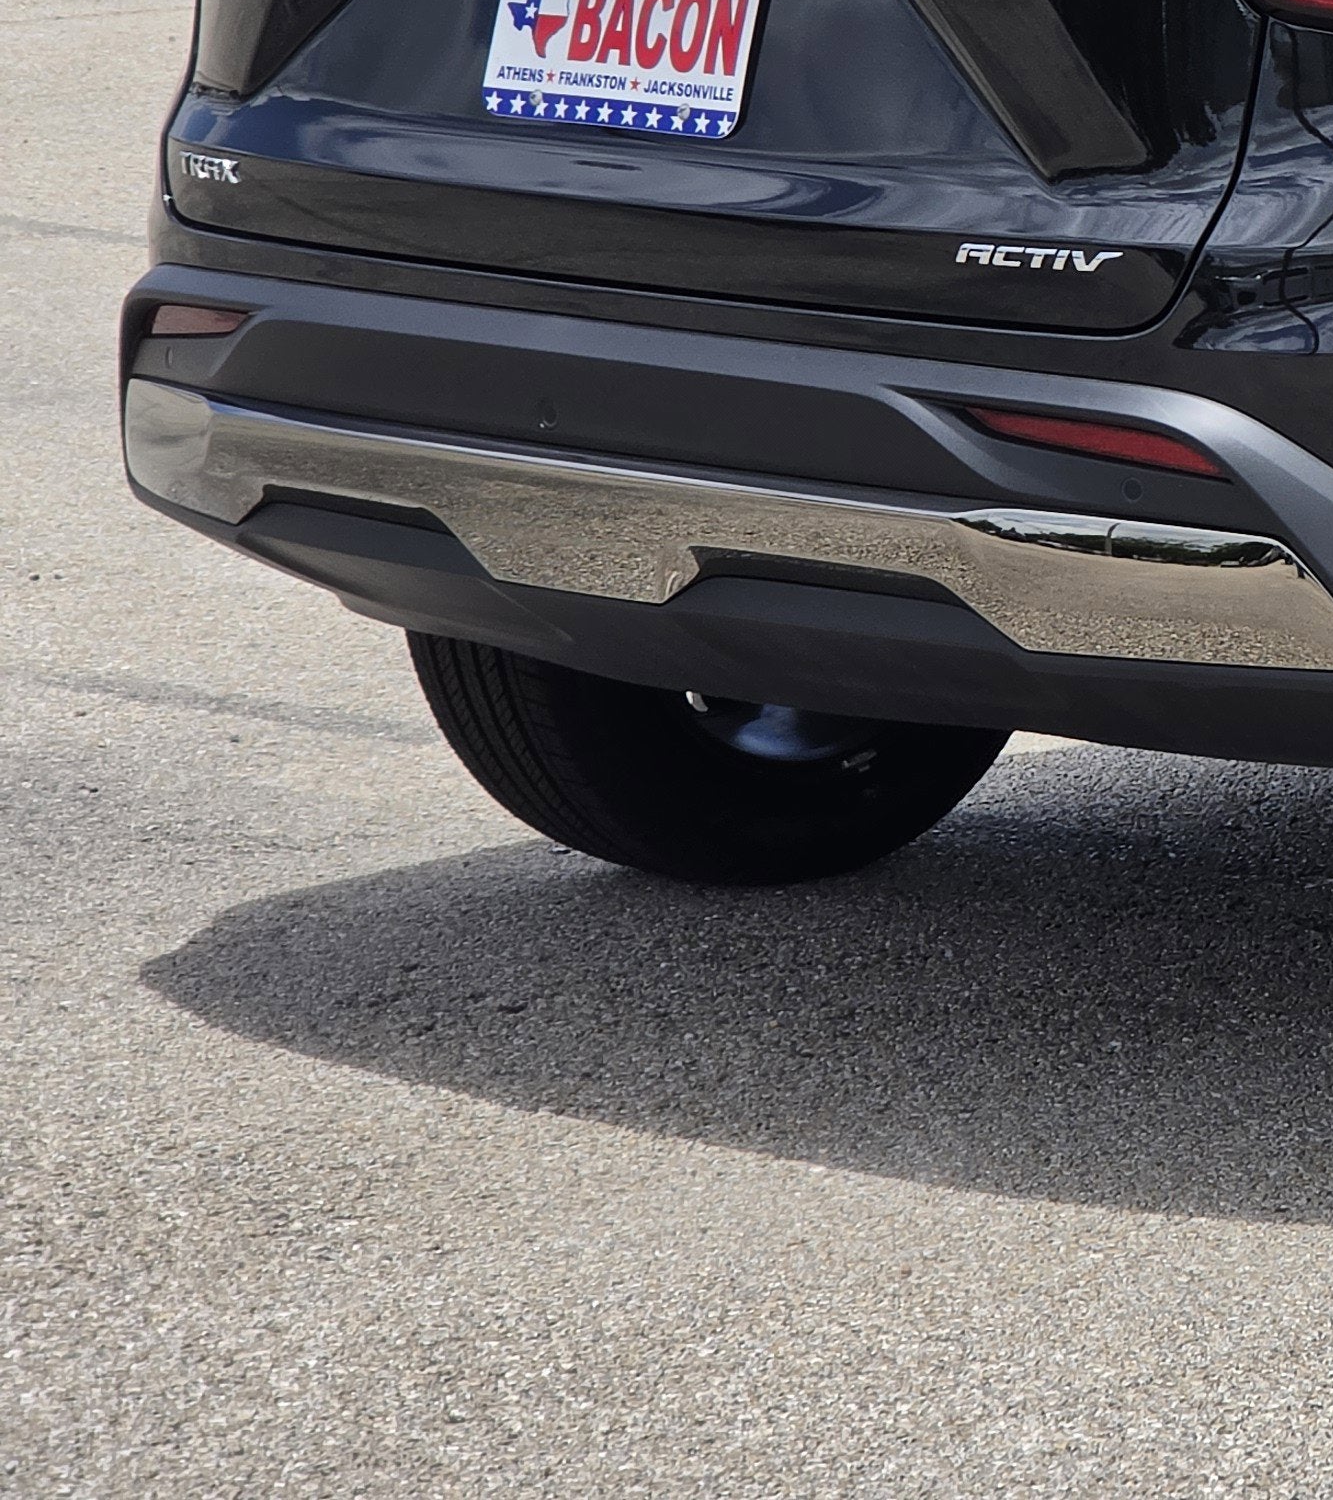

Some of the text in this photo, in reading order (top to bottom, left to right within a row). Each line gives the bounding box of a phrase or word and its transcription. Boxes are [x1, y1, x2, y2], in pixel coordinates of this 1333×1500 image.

[496, 65, 735, 101] ATHENS FRANKSTON JACKSONVILLE
[955, 242, 1124, 272] ACTIV
